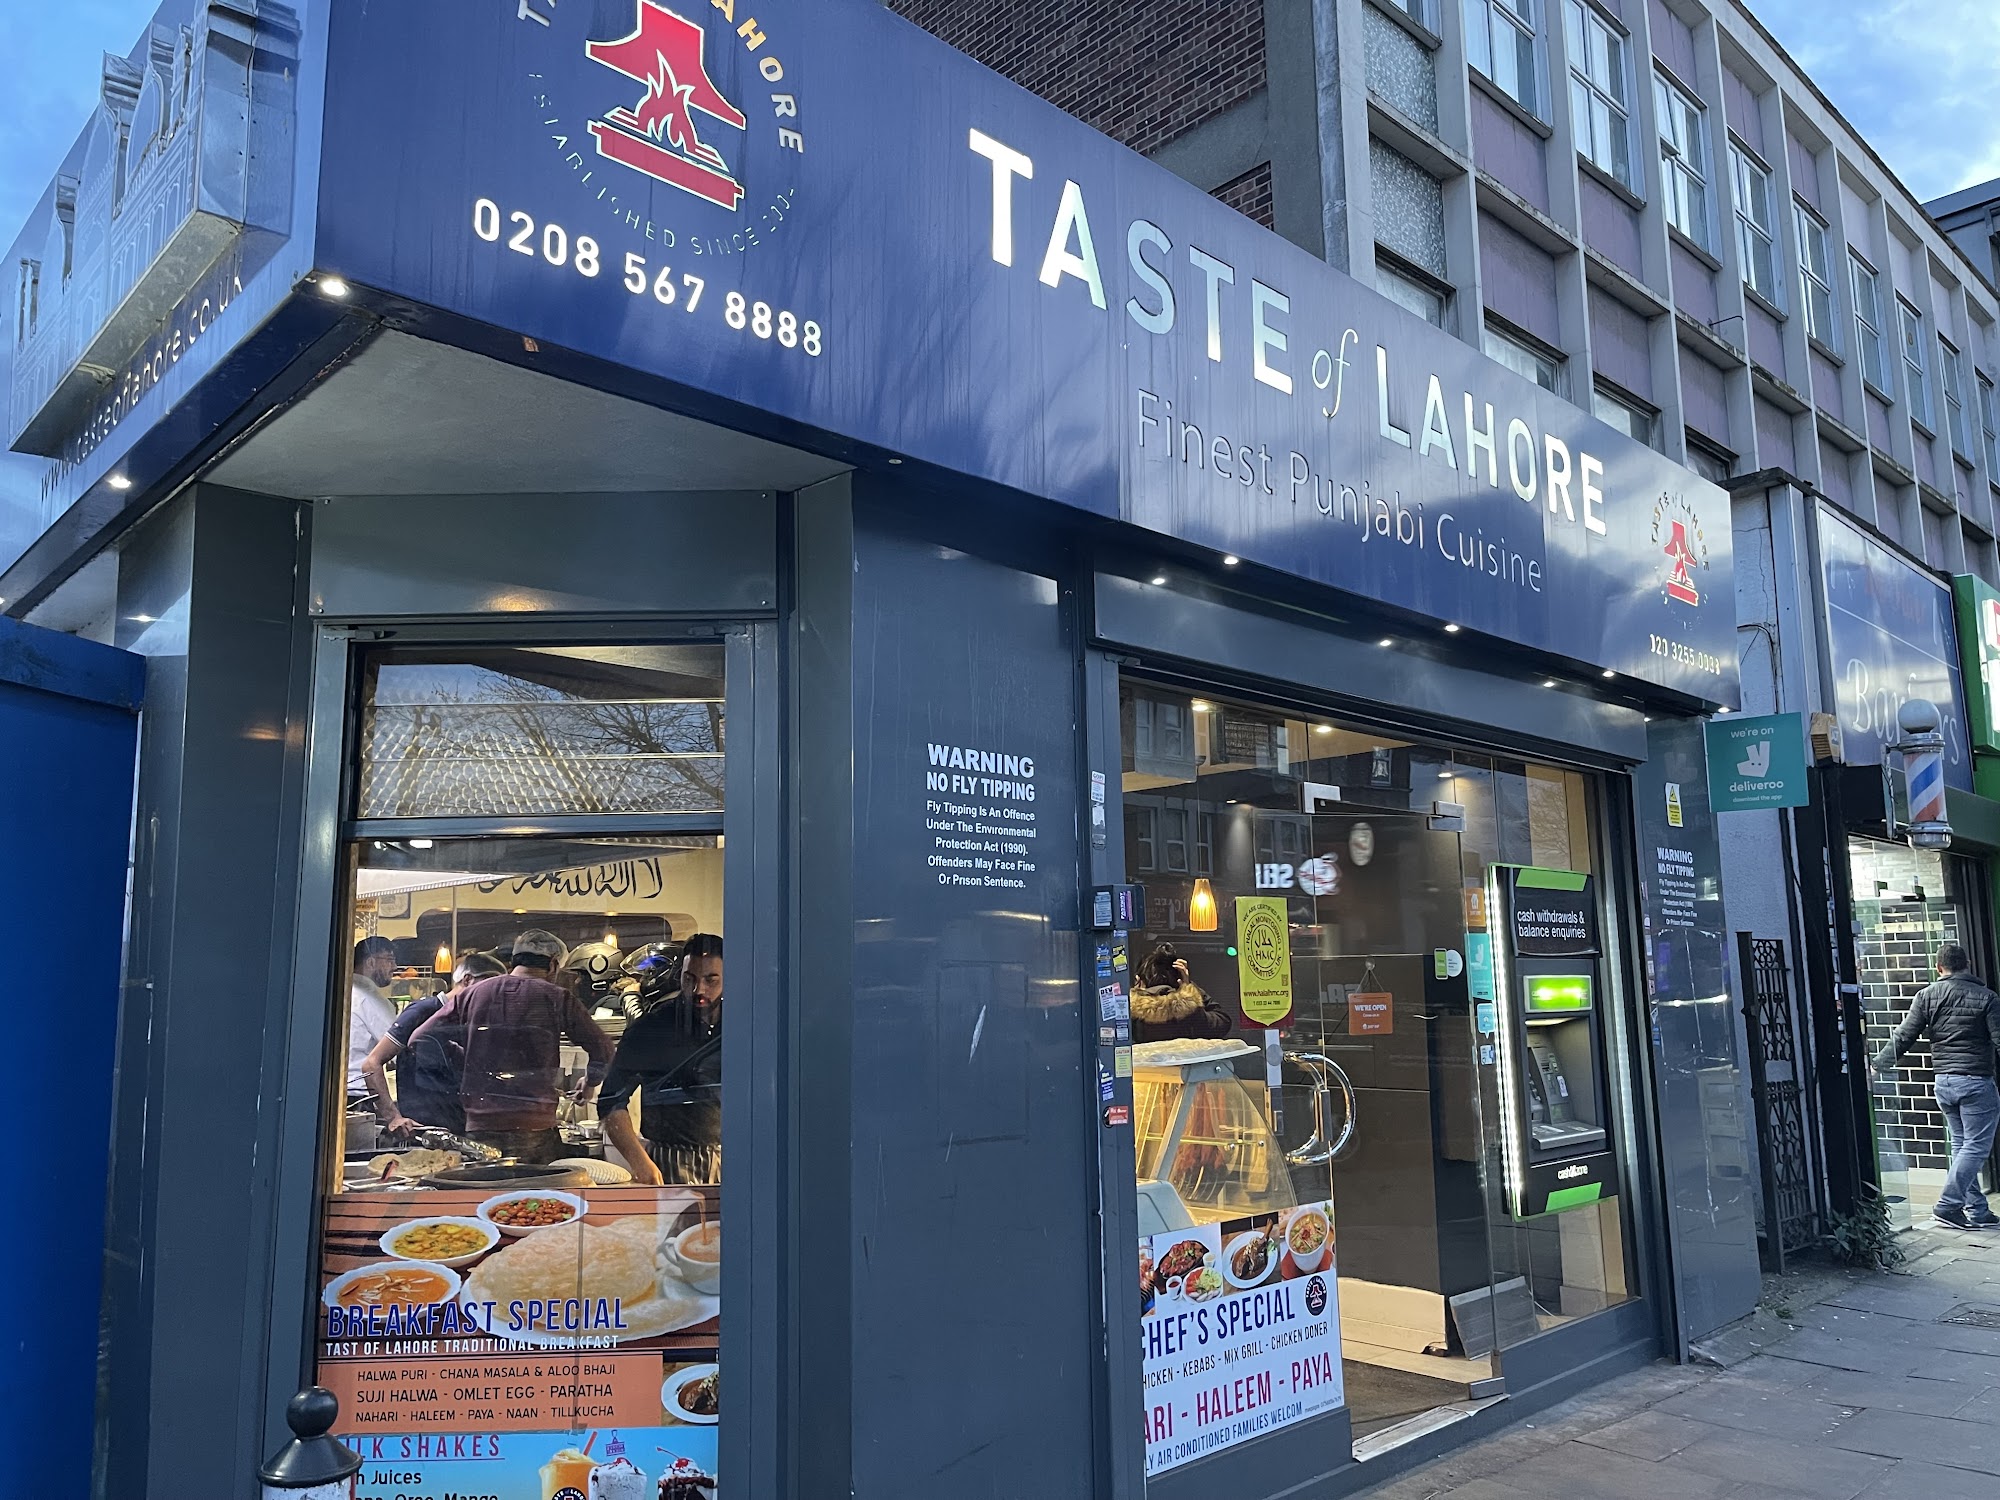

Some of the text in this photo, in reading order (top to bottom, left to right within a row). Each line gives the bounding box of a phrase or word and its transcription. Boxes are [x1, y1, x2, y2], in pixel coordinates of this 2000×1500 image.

[711, 0, 804, 153] AHORE
[474, 198, 822, 357] 0208 567 8888
[968, 128, 1608, 537] TASTE of LAHORE
[1137, 387, 1543, 593] Finest Punjabi Cuisine
[1671, 642, 1695, 666] 3255
[1731, 727, 1774, 739] we're on
[927, 743, 1035, 778] WARNING
[926, 772, 1035, 801] NO FLY TIPPING
[1729, 780, 1784, 792] deliveroo
[926, 800, 1035, 821] Fly Tipping Is An Offence
[926, 818, 1036, 838] Under The Environmental
[935, 837, 1029, 855] Protection Act (1990).
[1657, 847, 1693, 864] WARNING
[927, 855, 1036, 872] Offenders May Face Fine
[1658, 863, 1694, 877] NO FLY TIPPING
[938, 873, 1026, 888] Or Prison Sentence.
[1517, 908, 1585, 924] cash withdrawals &
[1518, 924, 1586, 940] balance enquiries
[1256, 951, 1275, 960] HMC
[327, 1297, 628, 1339] BREAKFAST SPECIAL
[1216, 1287, 1296, 1340] SPECIAL
[326, 1335, 619, 1356] TAST OF LAHORE TRADITIONAL BREAKFAST
[1143, 1366, 1174, 1391] HICKEN
[1183, 1354, 1216, 1378] KEBABS
[1241, 1340, 1264, 1360] GRILL
[1271, 1328, 1303, 1350] CHICKEN
[1305, 1321, 1328, 1341] DONER
[357, 1369, 398, 1382] HALWA
[401, 1368, 428, 1381] PURI
[439, 1367, 480, 1380] CHANA
[483, 1366, 530, 1379] MASALA
[533, 1365, 544, 1378] &
[547, 1364, 580, 1377] ALOO
[583, 1363, 616, 1376] BHAJI
[356, 1389, 385, 1404] SUJI
[389, 1388, 439, 1403] HALWA
[453, 1387, 501, 1401] OMLET
[506, 1386, 535, 1399] EGG
[550, 1384, 613, 1399] PARATHA
[1144, 1402, 1173, 1445] ARI
[1196, 1371, 1272, 1427] HALEEM
[1291, 1351, 1333, 1394] PAYA
[355, 1409, 399, 1423] NAHARI
[410, 1408, 456, 1422] HALEEM
[467, 1407, 495, 1421] PAYA
[506, 1406, 539, 1419] NAAN
[551, 1405, 614, 1418] TILLKUCHA
[1157, 1451, 1173, 1467] AIR
[1175, 1426, 1230, 1460] CONDITIONED
[1232, 1413, 1269, 1439] FAMILIES
[1270, 1401, 1303, 1425] WELCOM
[346, 1434, 499, 1459] ILK SHAKES
[371, 1469, 422, 1485] Juices
